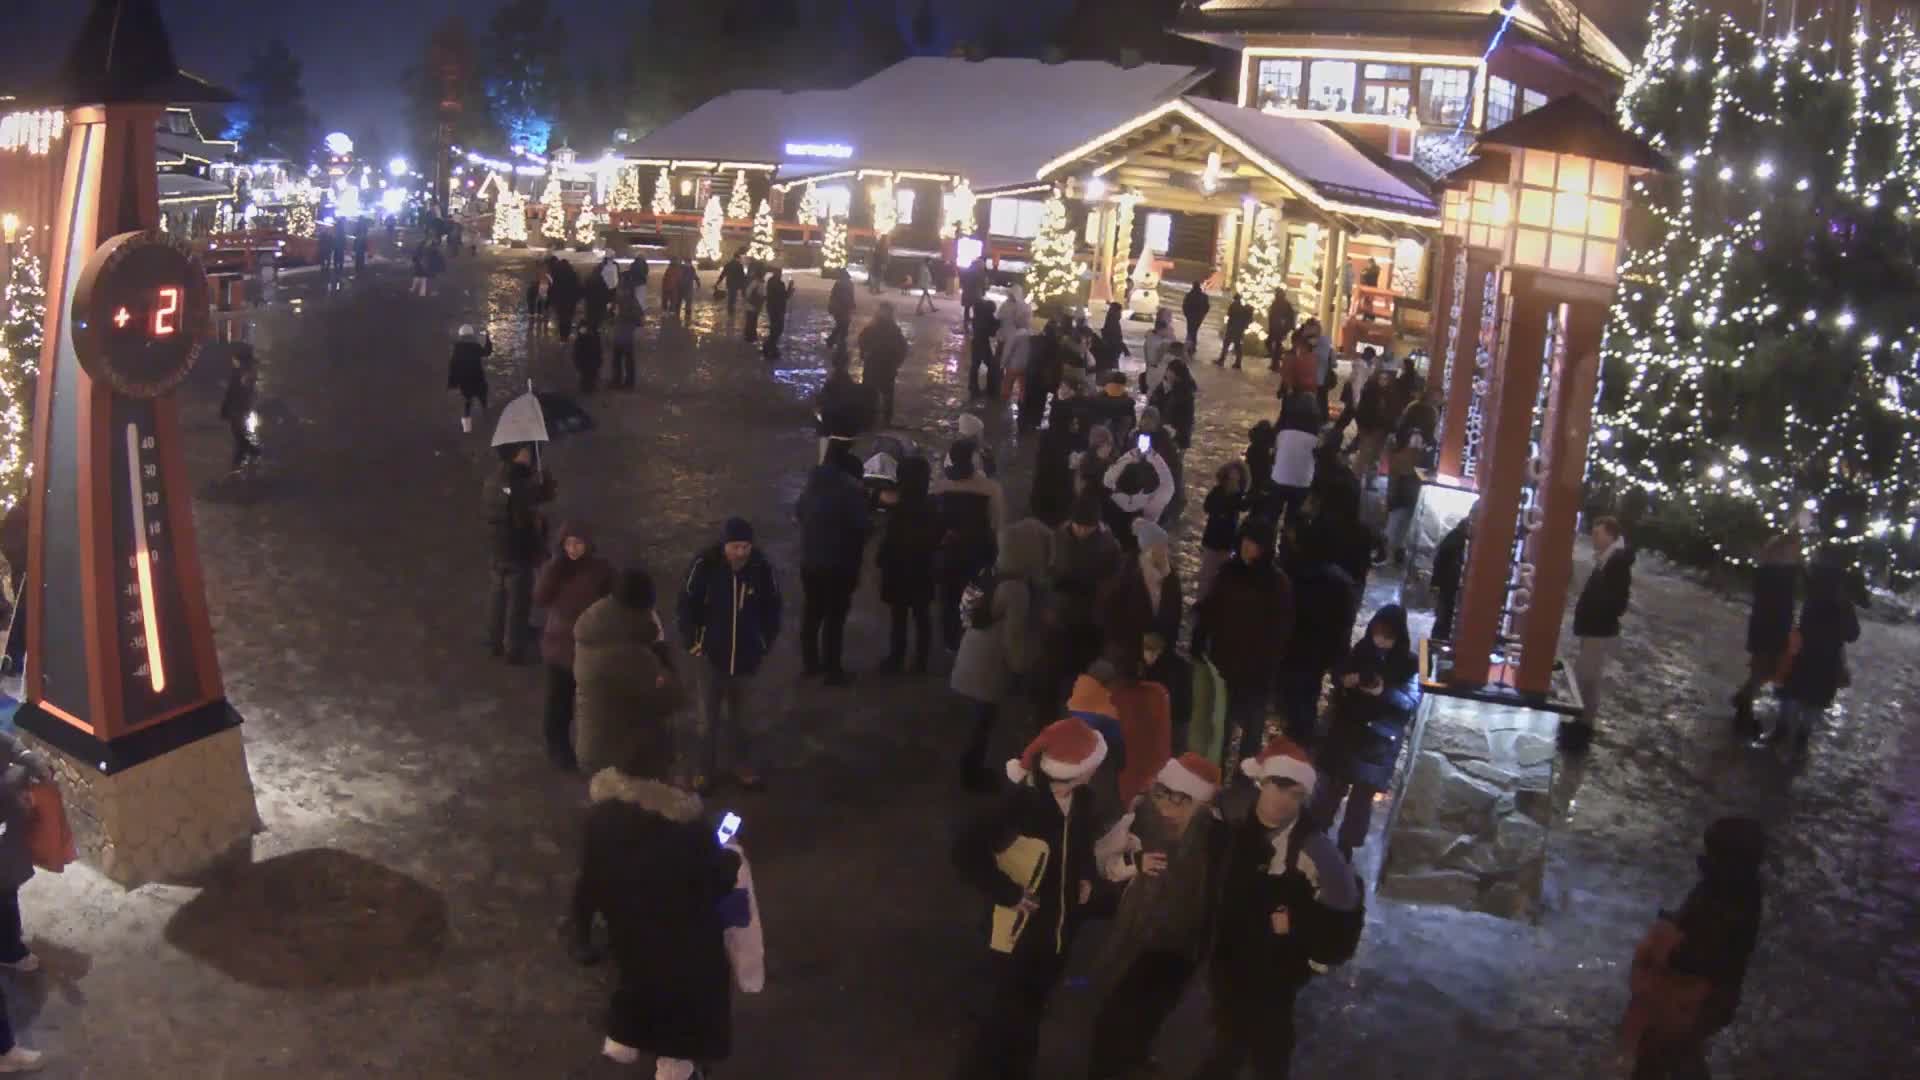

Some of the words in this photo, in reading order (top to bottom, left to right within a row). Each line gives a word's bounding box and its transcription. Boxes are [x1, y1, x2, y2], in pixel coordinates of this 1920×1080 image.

[155, 289, 178, 335] 2
[144, 463, 156, 478] 30
[145, 492, 159, 506] 20
[149, 520, 160, 535] 10
[152, 550, 159, 563] 0
